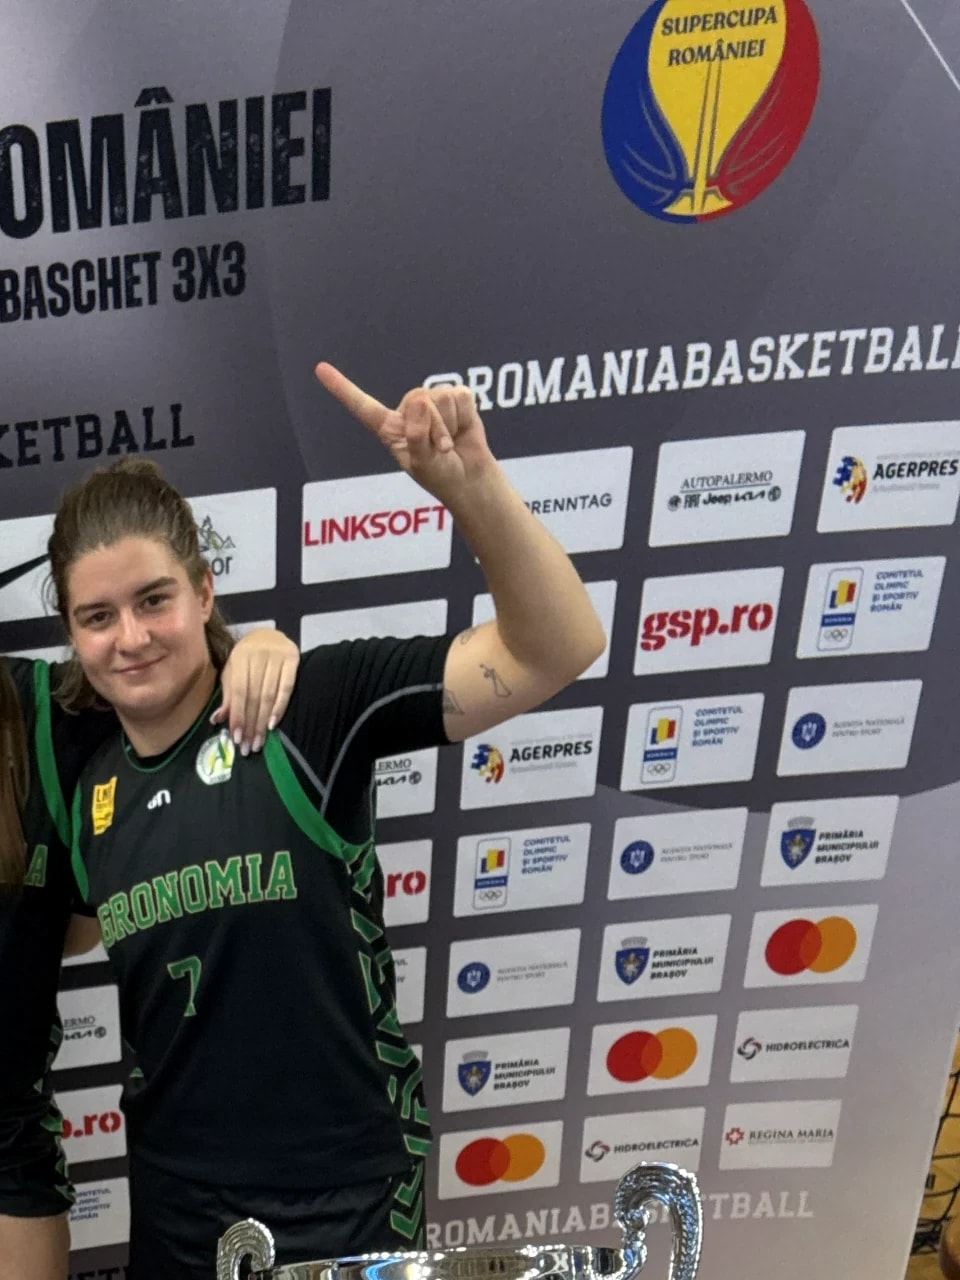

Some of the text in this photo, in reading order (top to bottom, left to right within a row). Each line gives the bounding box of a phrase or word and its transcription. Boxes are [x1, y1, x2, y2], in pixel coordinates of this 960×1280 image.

[660, 5, 778, 37] SUPERCUPA
[667, 38, 766, 67] ROMÂNIEI
[423, 323, 960, 411] ROMANIABASKETBAL
[681, 470, 773, 489] AUTOPALERMO
[873, 459, 959, 480] AGERPRES
[303, 505, 447, 546] LINKSOFT
[640, 602, 773, 652] gsp.ro
[510, 740, 593, 763] AGERPRES
[167, 955, 202, 1017] 7
[765, 1039, 850, 1053] HIDROELECTRICA
[614, 1138, 699, 1154] HIDROELECTRICA
[749, 1128, 834, 1140] REGINA MARIA
